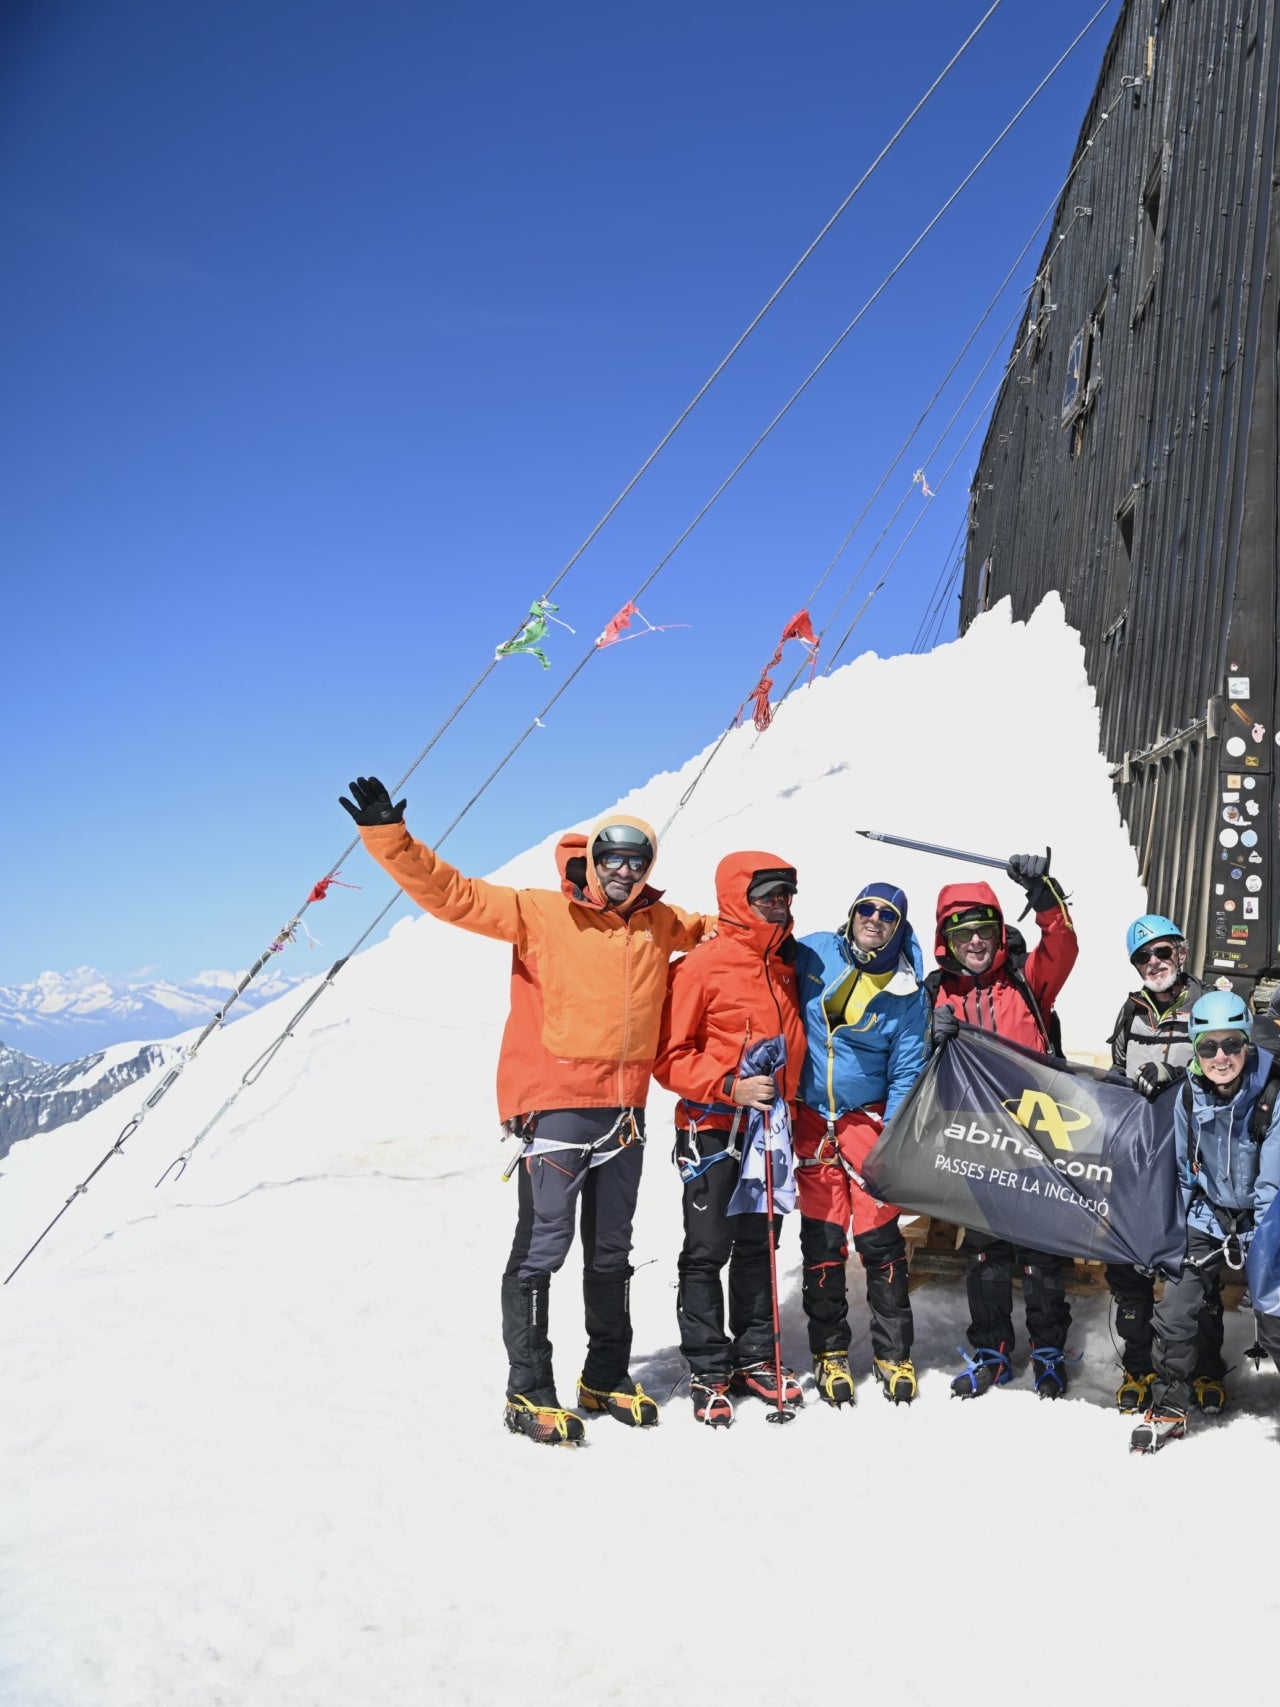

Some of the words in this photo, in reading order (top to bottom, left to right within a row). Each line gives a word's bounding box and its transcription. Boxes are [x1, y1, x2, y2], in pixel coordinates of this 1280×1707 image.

[935, 1154, 986, 1180] PASSES
[989, 1168, 1018, 1188] PER
[1021, 1176, 1040, 1195] LA
